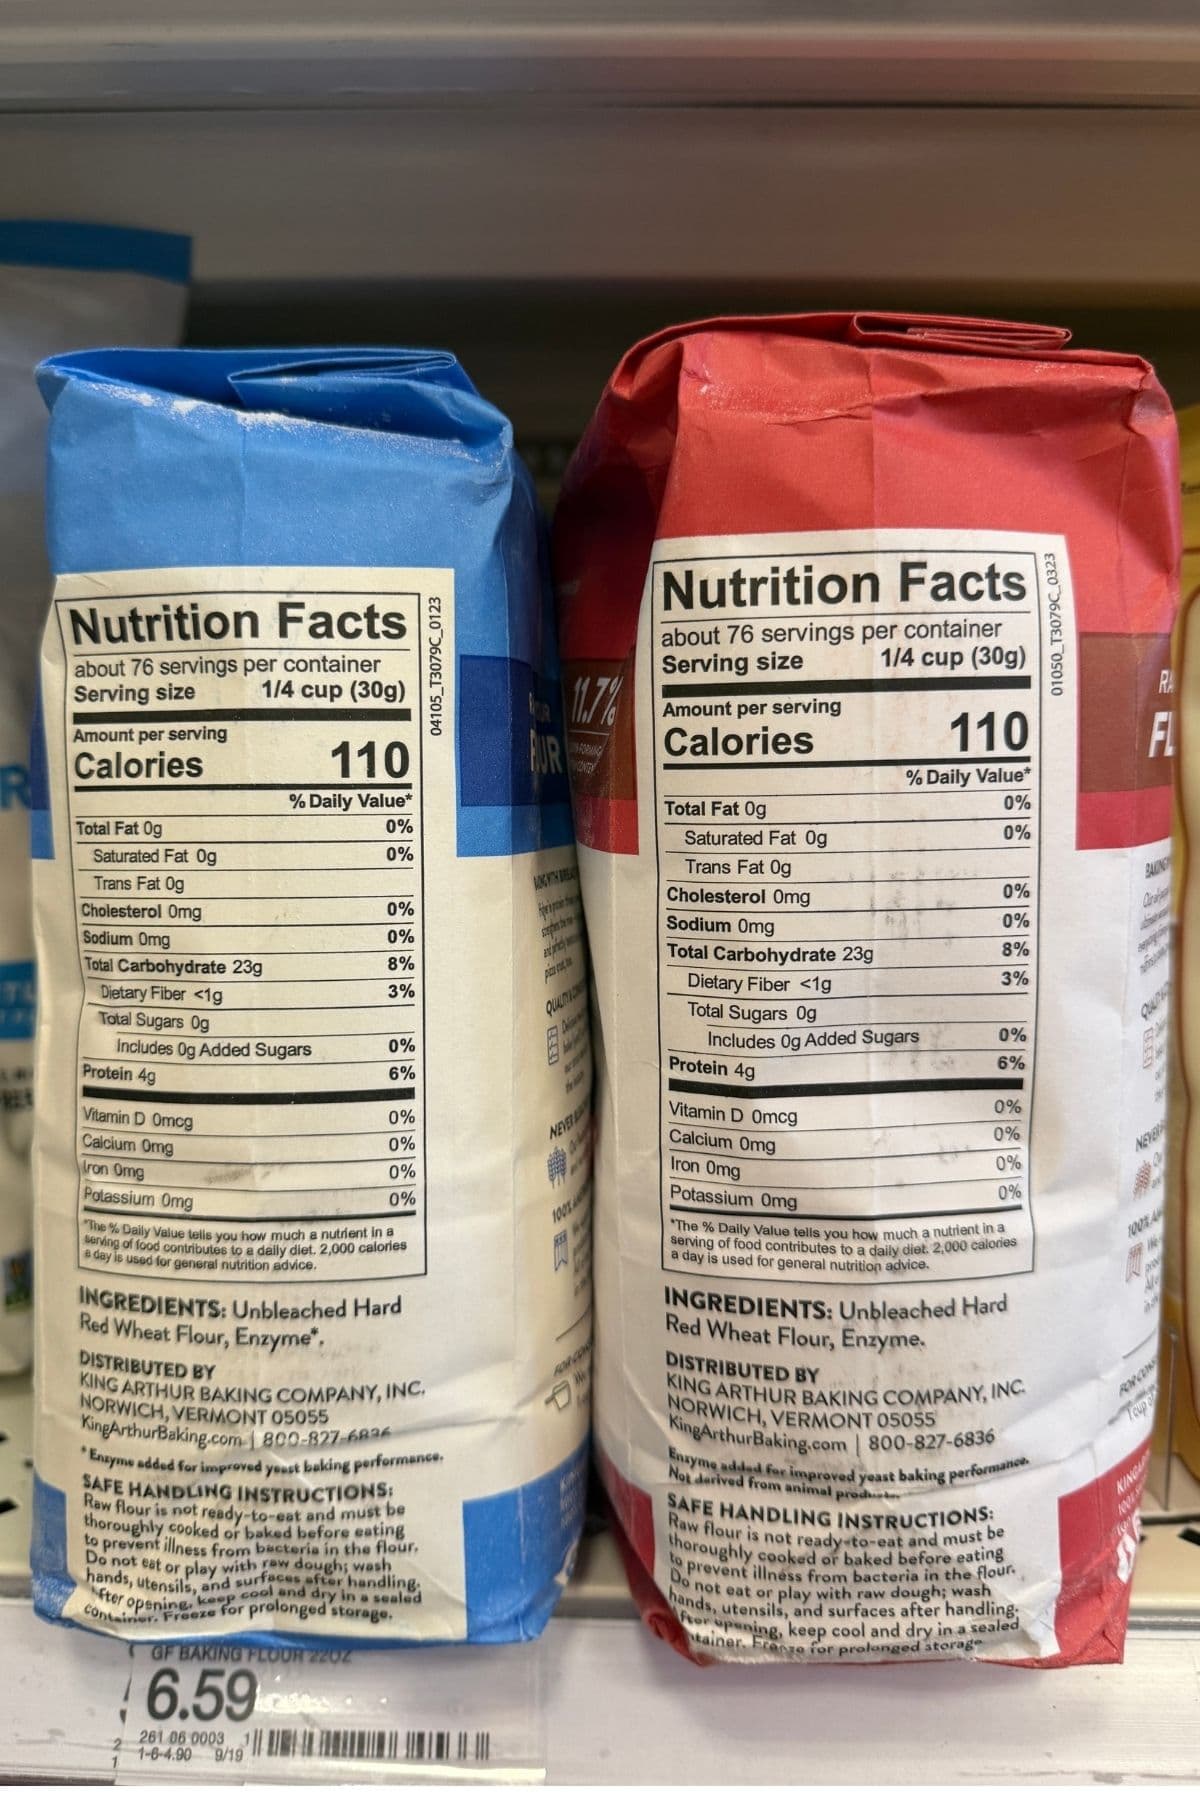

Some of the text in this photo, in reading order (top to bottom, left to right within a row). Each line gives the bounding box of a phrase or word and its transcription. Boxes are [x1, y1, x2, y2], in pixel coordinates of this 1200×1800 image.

[663, 561, 1027, 611] Nutrition Facts
[70, 601, 407, 646] Nutrition Facts
[662, 619, 1002, 647] about 76 servings per container
[1044, 553, 1064, 696] 01050_T3079C_0323
[75, 655, 381, 678] about 76 servings per container
[429, 597, 444, 736] 04105_T3079C_0123
[662, 646, 1026, 676] Serving size 1/4 cup (30g)
[74, 679, 406, 705] Serving size 1/4 cup (30g)
[572, 676, 623, 726] 11.7%
[663, 698, 841, 719] Amount per serving
[664, 711, 1028, 756] Calories 110
[74, 740, 410, 779] Calories 110
[906, 770, 922, 785] %
[927, 769, 971, 787] Daily
[289, 794, 306, 809] %
[309, 794, 353, 811] Daily
[664, 795, 1031, 819] Total Fat 0g 0%
[685, 825, 1031, 848] Saturated Fat 0g 0%
[685, 859, 791, 878] Trans Fat 0g
[667, 883, 1030, 907] Cholesterol 0mg 0%
[81, 901, 414, 922] Cholesterol 0mg 0%
[667, 913, 1030, 937] Sodium 0mg 0%
[85, 956, 415, 977] Total Carbohydrate 23g 8%
[667, 941, 1029, 966] Total Carbohydrate 23g 8%
[688, 971, 1029, 994] Dietary Fiber <1g 3%
[688, 1001, 816, 1024] Total Sugars 0g
[708, 1027, 1027, 1052] Includes 0g Added Sugars 0%
[669, 1056, 1025, 1081] Protein 4g 6%
[669, 1100, 1022, 1126] Vitamin D 0mcg 0%
[669, 1127, 1020, 1155] Calcium 0mg 0%
[671, 1156, 1021, 1181] Iron 0mg 0%
[670, 1184, 1022, 1211] Potassium 0mg 0%
[671, 1250, 930, 1273] a day is used for general nutrition advice.
[80, 1285, 401, 1320] INGREDIENTS: Unbleached Hard
[665, 1286, 1007, 1321] INGREDIENTS: Unbleached Hard
[80, 1313, 109, 1334] Red
[114, 1316, 171, 1342] Wheat
[177, 1324, 230, 1349] Flour,
[666, 1314, 925, 1354] Red Wheat Flour, Enzyme.
[666, 1351, 819, 1383] DISTRIBUTED BY
[667, 1373, 1025, 1407] KING ARTHUR BAKING COMPANY, INC.
[668, 1396, 936, 1429] NORWICH, VERMONT 05055
[669, 1415, 995, 1454] KingArthurBaking.com 800-827-6836
[668, 1494, 994, 1530] SAFE HANDLING INSTRUCTIONS:
[179, 1647, 241, 1662] BAKING
[147, 1667, 258, 1722] 6.59
